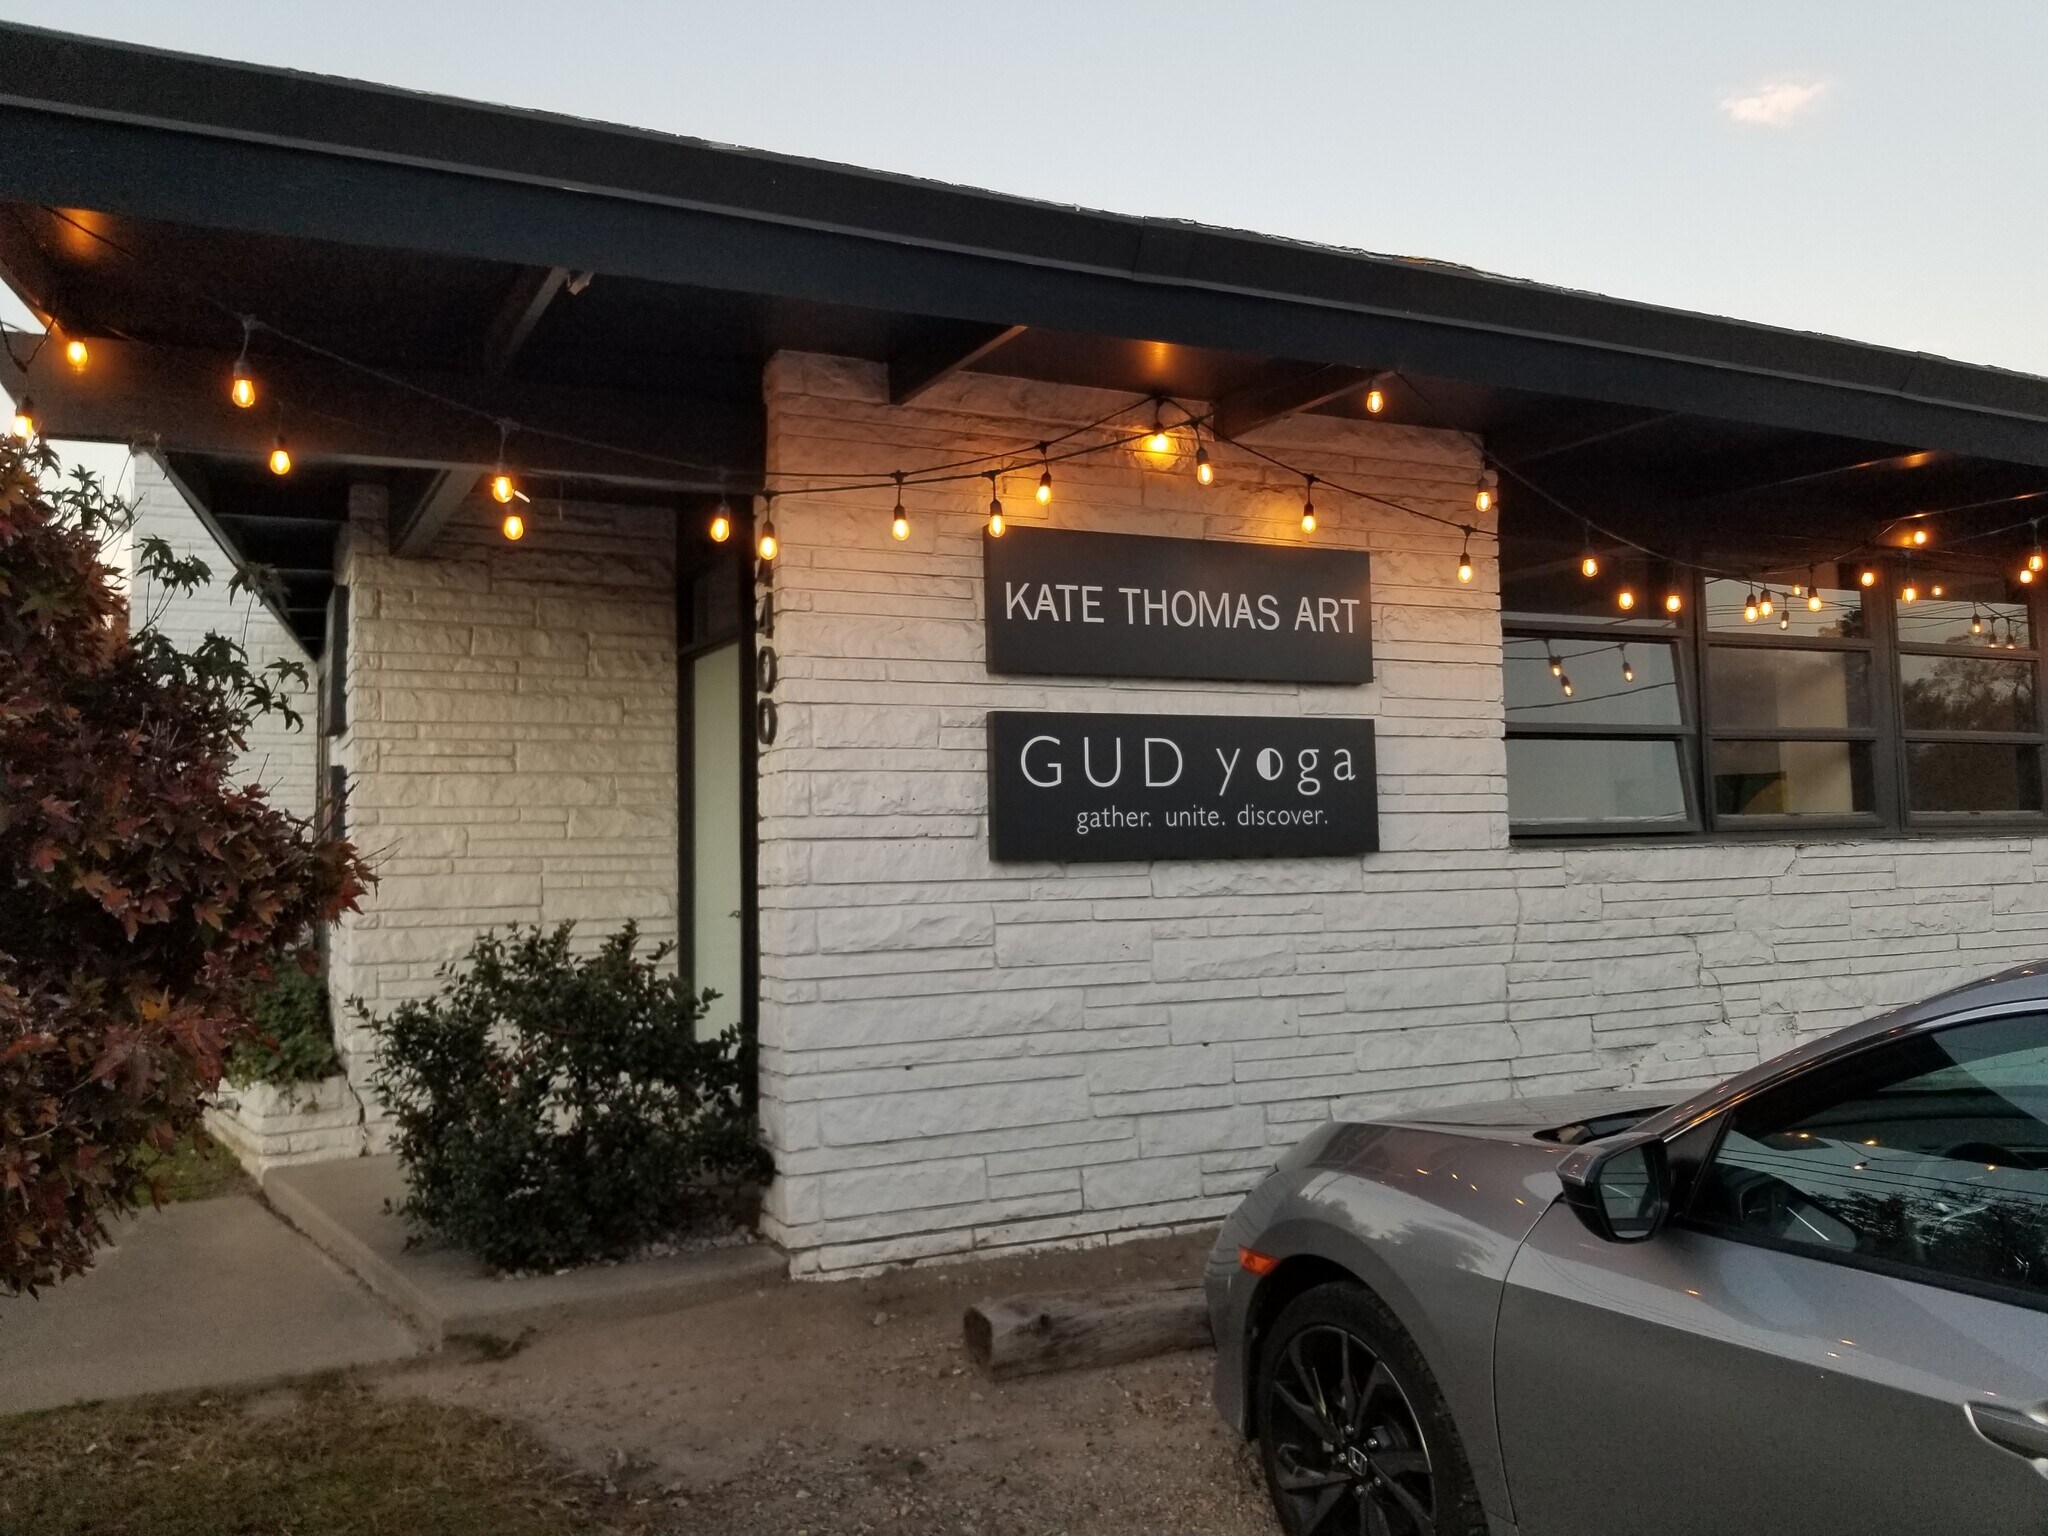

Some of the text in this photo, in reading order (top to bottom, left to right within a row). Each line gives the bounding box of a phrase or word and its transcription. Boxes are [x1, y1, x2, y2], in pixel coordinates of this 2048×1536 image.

[1006, 582, 1360, 633] KATE THOMAS ART
[1021, 736, 1355, 796] GUD yoga
[1077, 804, 1327, 834] gather. unite. discover.
